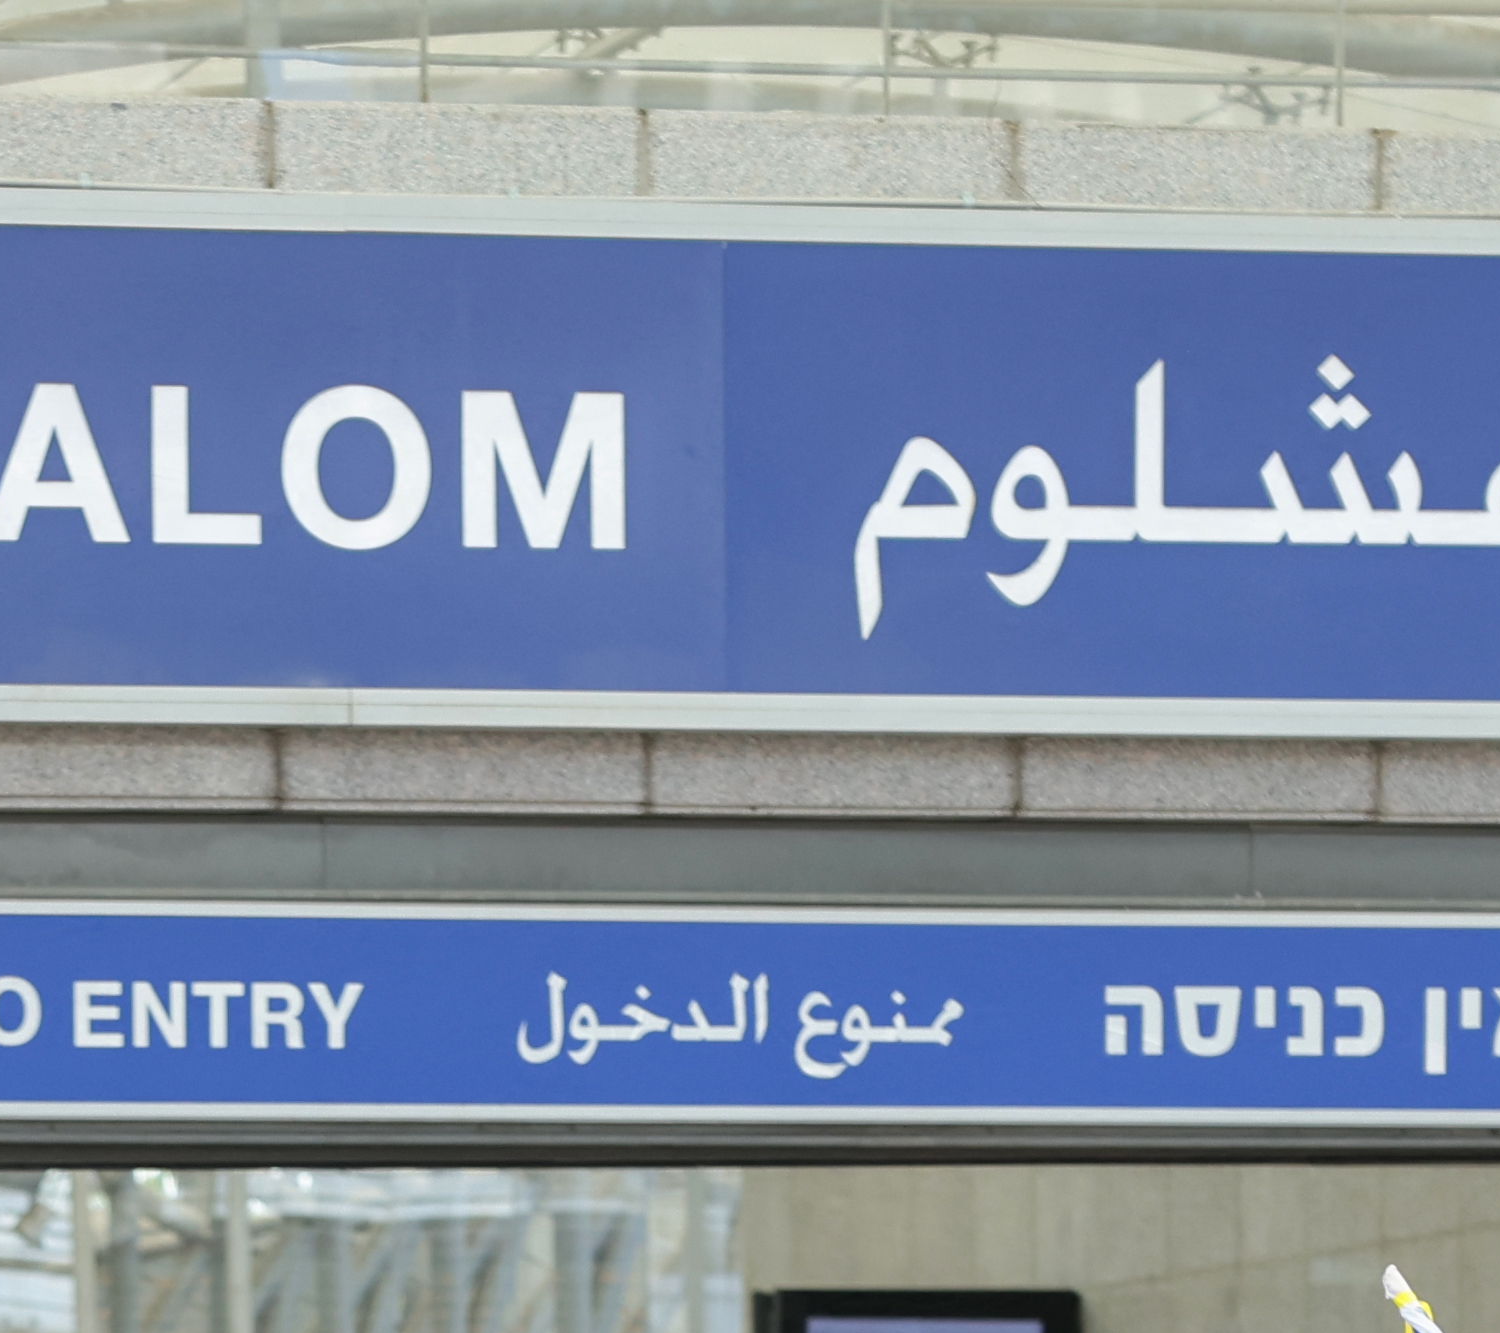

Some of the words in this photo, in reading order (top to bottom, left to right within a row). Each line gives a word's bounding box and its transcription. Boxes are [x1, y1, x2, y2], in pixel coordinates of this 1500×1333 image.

[73, 980, 364, 1050] ENTRY
[517, 971, 769, 1065] الدخول
[1104, 985, 1385, 1057] כניסה
